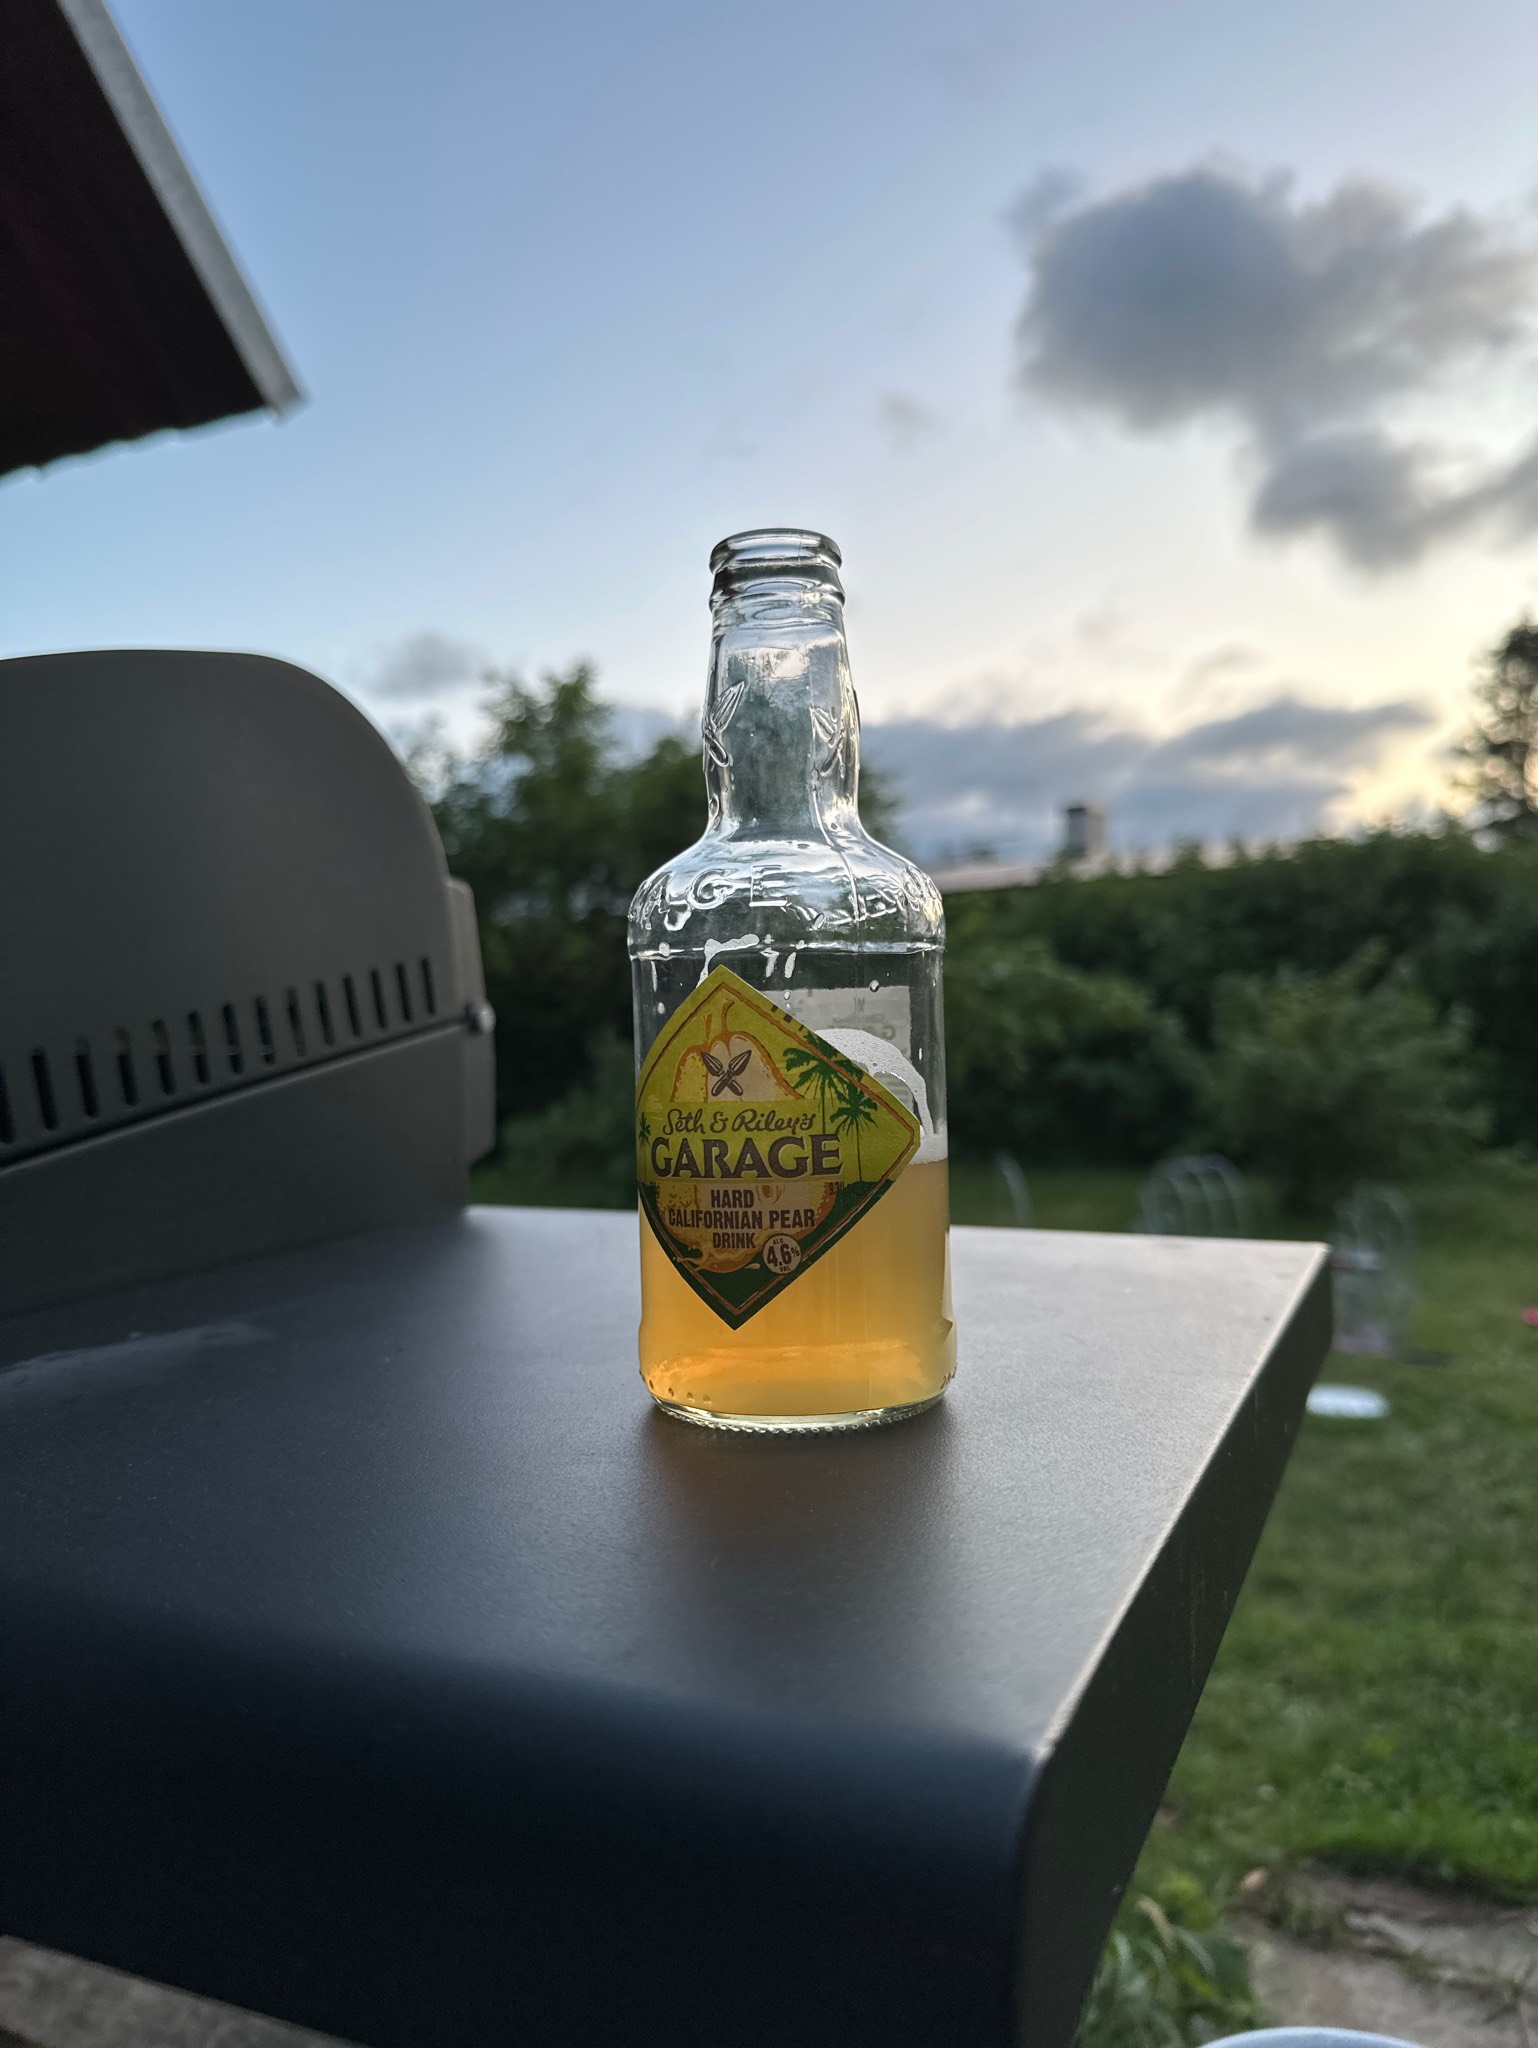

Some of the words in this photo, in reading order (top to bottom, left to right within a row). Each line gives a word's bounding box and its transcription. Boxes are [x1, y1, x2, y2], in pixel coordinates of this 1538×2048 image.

[663, 1108, 706, 1135] Seth
[710, 1111, 729, 1133] &
[732, 1108, 816, 1135] Riley's
[652, 1135, 842, 1178] GARAGE
[711, 1190, 755, 1208] HARD
[669, 1209, 763, 1229] CALIFORNIAN
[770, 1209, 816, 1229] PEAR
[713, 1232, 756, 1249] DRINK
[772, 1237, 784, 1245] ALC
